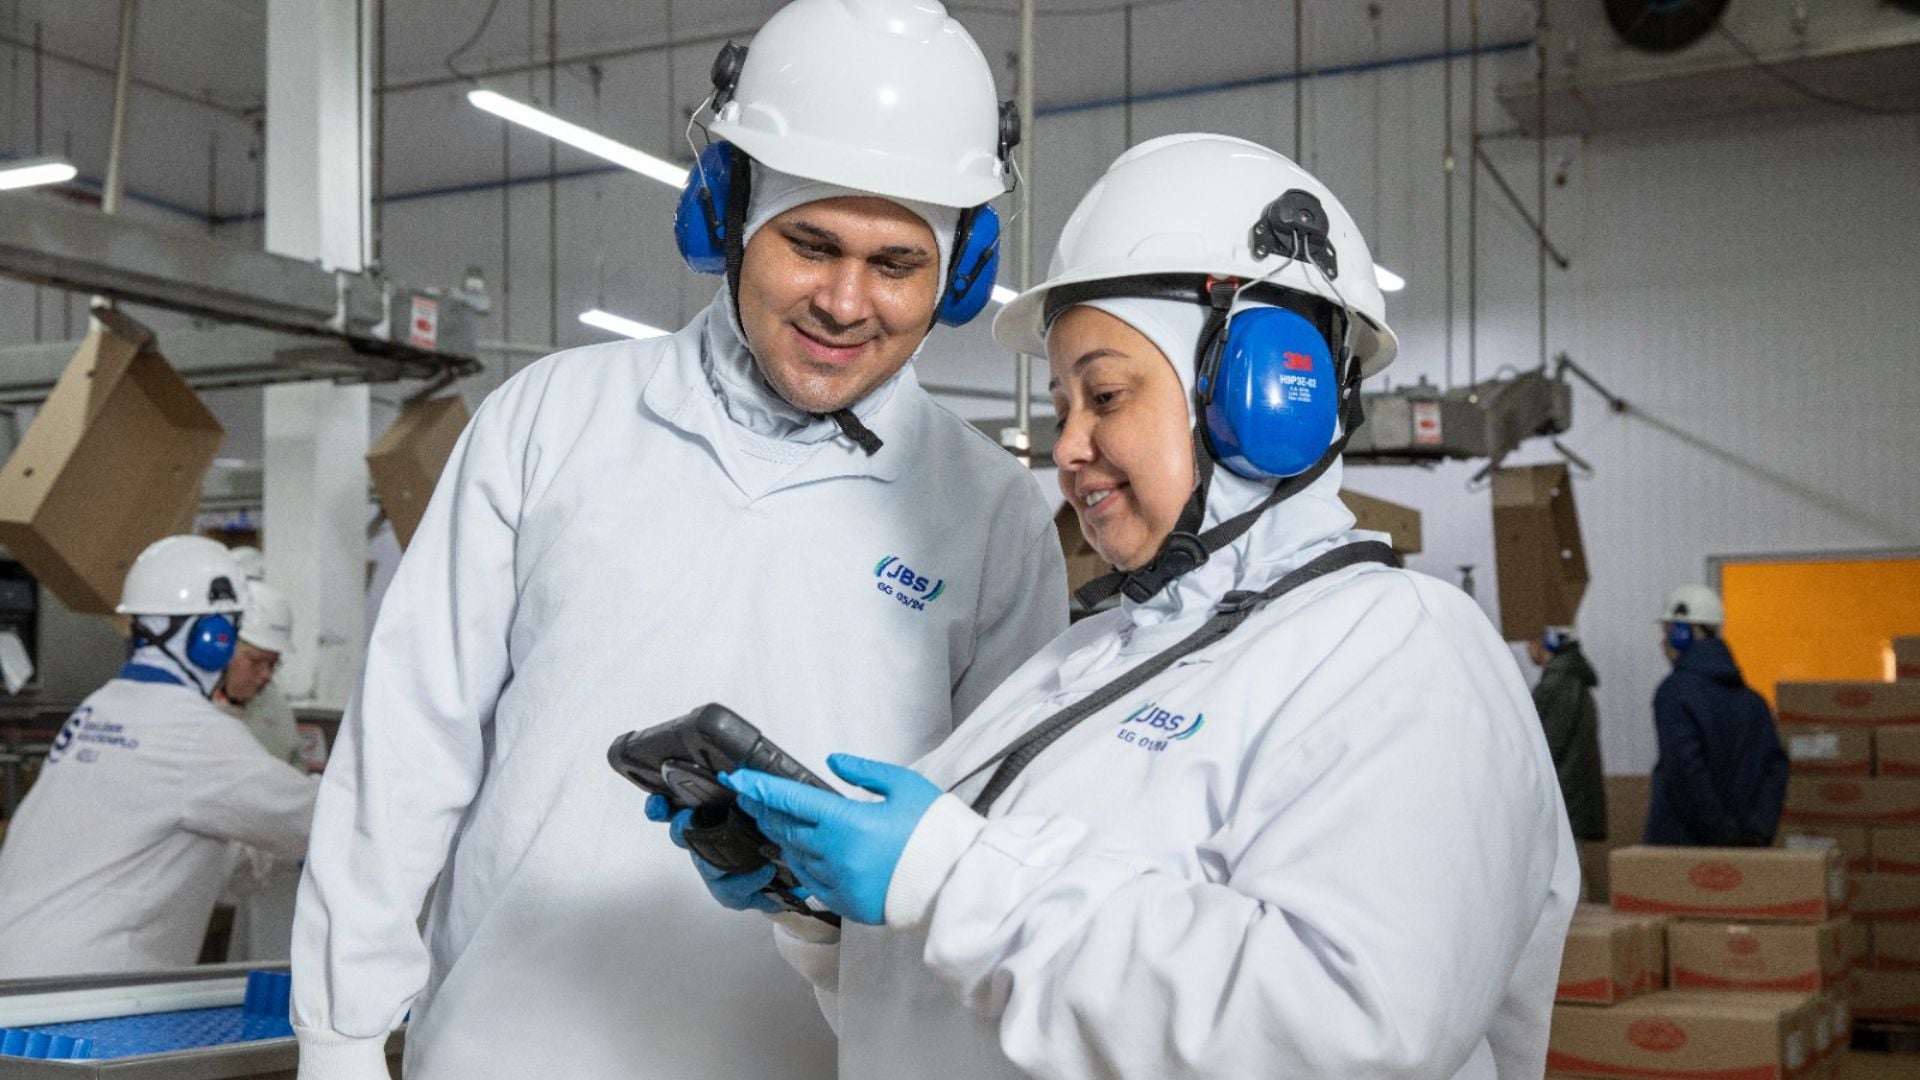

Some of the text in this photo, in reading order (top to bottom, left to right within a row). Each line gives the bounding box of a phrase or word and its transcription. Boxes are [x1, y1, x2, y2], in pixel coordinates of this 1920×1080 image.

[1283, 351, 1313, 372] 3M
[887, 564, 929, 592] JBS
[1135, 707, 1184, 731] JBS
[1117, 728, 1137, 743] EG
